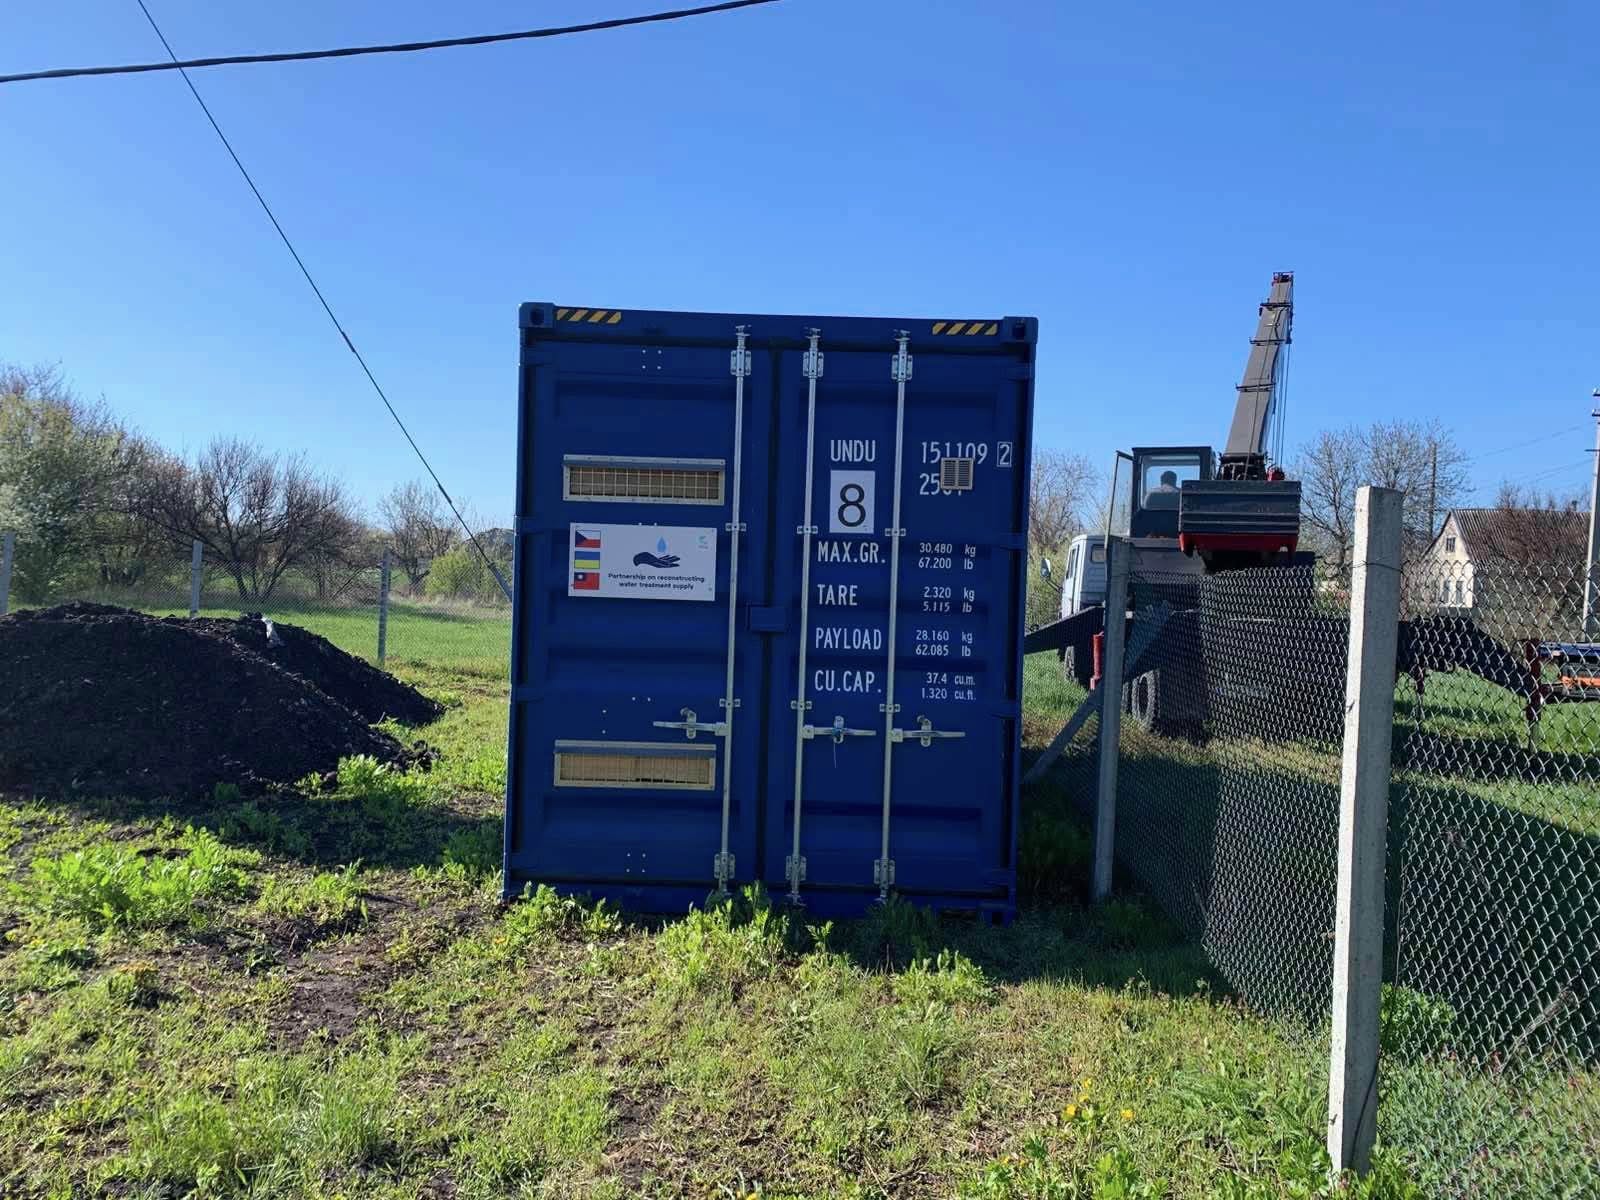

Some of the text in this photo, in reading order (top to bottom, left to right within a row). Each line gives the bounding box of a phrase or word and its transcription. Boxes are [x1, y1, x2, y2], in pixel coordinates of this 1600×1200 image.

[830, 439, 1011, 466] UNDU 151109 2
[837, 483, 866, 528] 8
[817, 541, 886, 564] MAX.GR.
[919, 542, 976, 556] 30.480 kg
[918, 557, 974, 570] 67.200 lb
[658, 574, 705, 583] reconstructing
[673, 583, 694, 591] supply
[923, 586, 975, 601] 2.320 kg
[817, 584, 858, 606] TARE
[923, 601, 973, 613] 5.115 lb
[815, 627, 882, 650] PAYLOAD
[916, 630, 973, 644] 28.160 kg
[915, 645, 971, 657] 62.085 lb
[814, 670, 882, 693] CU.CAP.
[926, 673, 948, 685] 37.4
[921, 688, 948, 700] 1.320
